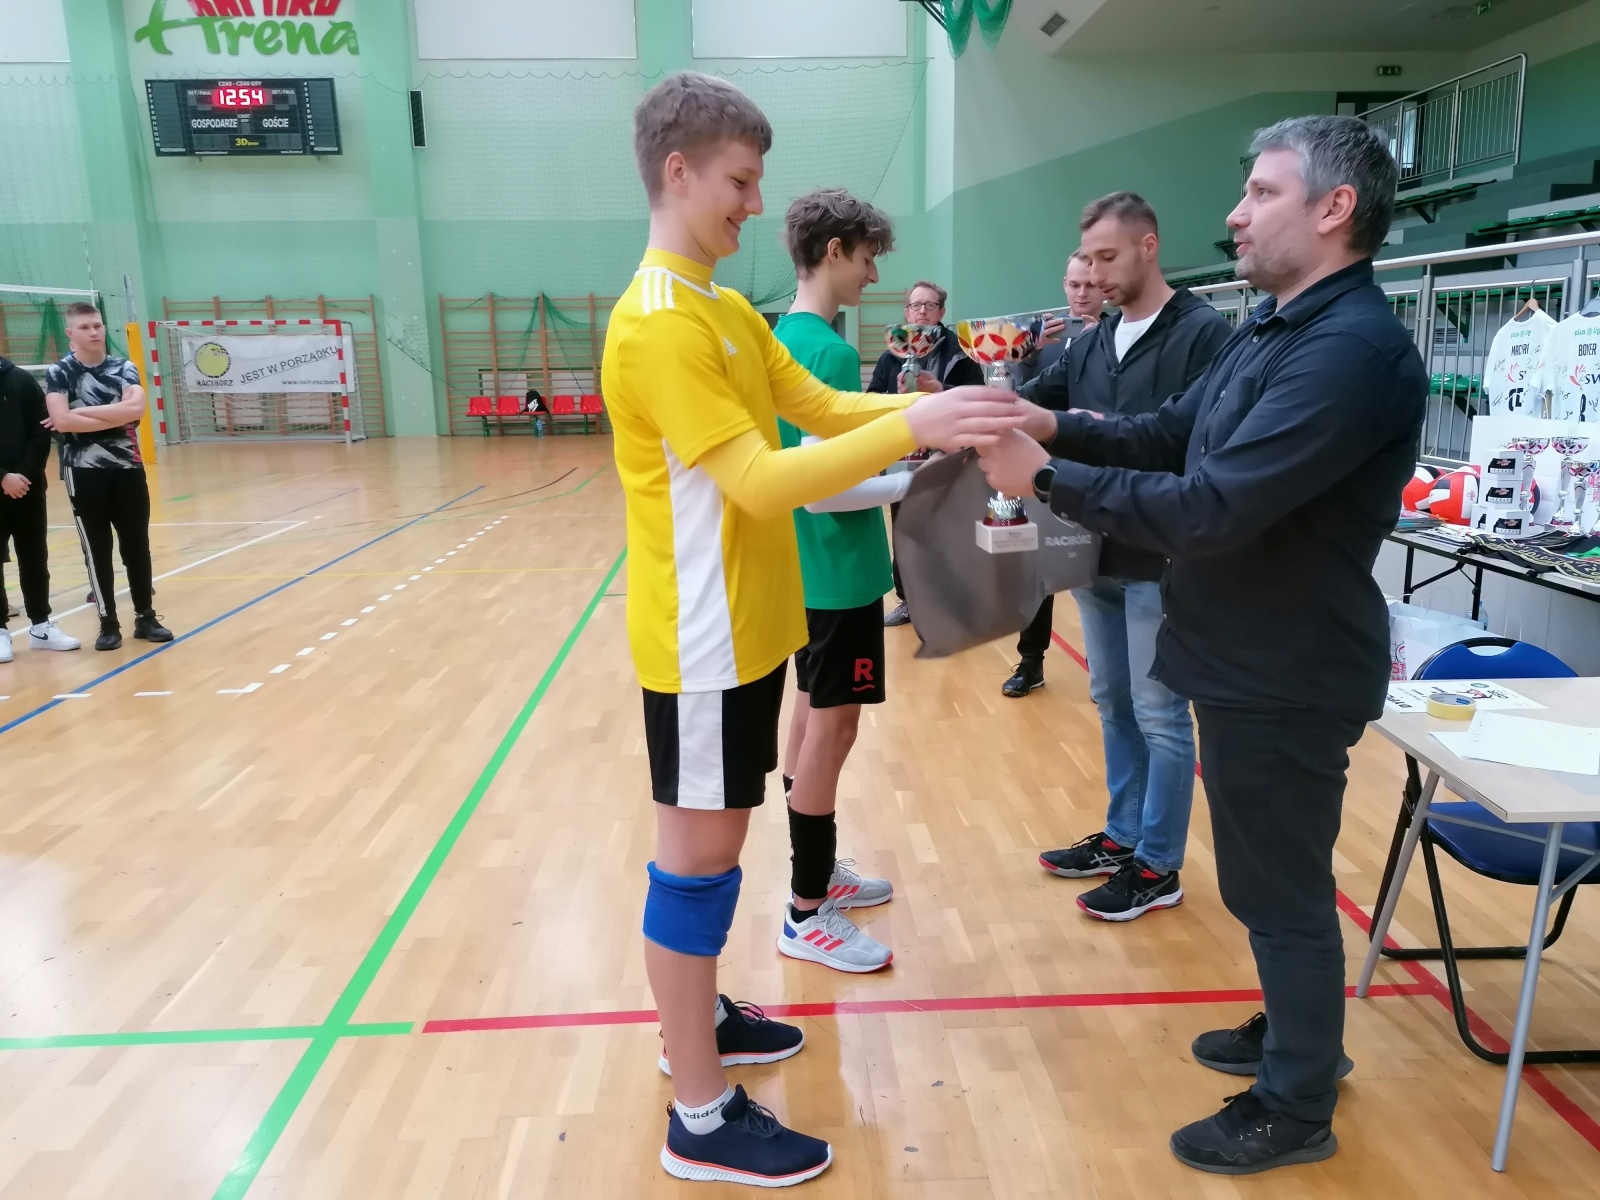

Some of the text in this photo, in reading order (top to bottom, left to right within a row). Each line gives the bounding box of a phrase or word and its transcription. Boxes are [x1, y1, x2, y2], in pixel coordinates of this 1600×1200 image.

[191, 118, 239, 128] GOSPODARZE
[262, 115, 289, 128] GOŚCIE
[240, 345, 339, 384] JEST W PORZĄDKU
[854, 658, 874, 682] R
[683, 1101, 726, 1120] adidas
